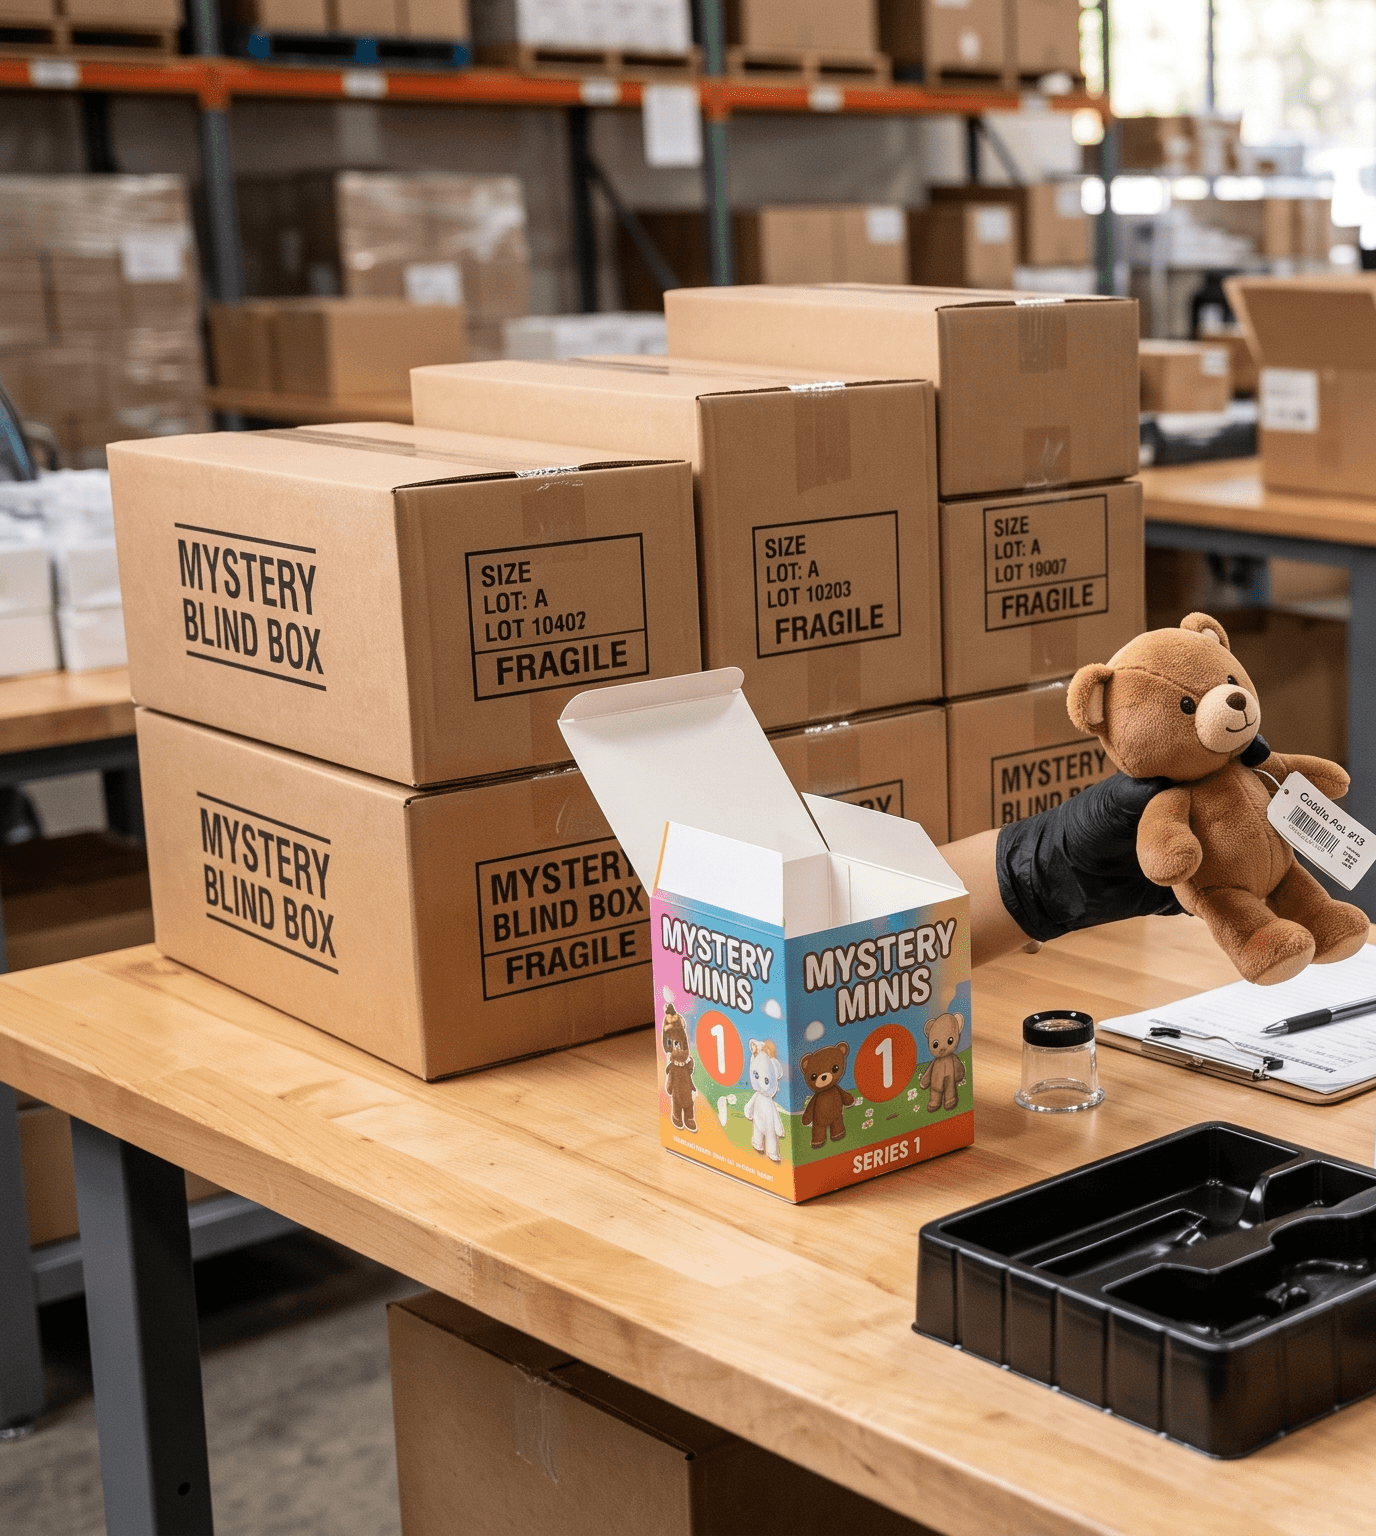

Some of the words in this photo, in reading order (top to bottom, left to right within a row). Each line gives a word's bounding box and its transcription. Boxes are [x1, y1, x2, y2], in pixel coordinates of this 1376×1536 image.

[765, 535, 806, 559] SIZE
[994, 516, 1029, 537] SIZE
[995, 540, 1026, 560] LOT:
[1030, 538, 1041, 556] A
[178, 539, 316, 615] MYSTERY
[481, 561, 532, 587] SIZE
[766, 562, 802, 583] LOT:
[808, 560, 819, 578] A
[767, 587, 800, 608] LOT
[806, 580, 851, 602] 10203
[995, 563, 1024, 583] LOT
[484, 591, 527, 614] LOT:
[534, 588, 548, 608] A
[775, 604, 884, 644] FRAGILE
[1002, 583, 1093, 620] FRAGILE
[183, 598, 258, 656] BLIND
[267, 618, 324, 674] BOX
[485, 618, 524, 642] LOT
[497, 640, 627, 685] FRAGILE
[1002, 748, 1106, 795] MYSTERY
[200, 807, 330, 900] MYSTERY
[204, 863, 275, 930] BLIND
[283, 895, 337, 958] BOX
[493, 899, 578, 943] BLIND
[589, 885, 643, 922] BOX
[506, 930, 636, 984] FRAGILE
[661, 914, 773, 982] MYSTERY
[804, 918, 957, 992] MYSTERY
[683, 957, 753, 1013] MINIS
[837, 966, 931, 1025] MINIS
[710, 1024, 726, 1074] 1
[875, 1037, 893, 1088] 1
[853, 1140, 909, 1174] SERIES
[913, 1136, 921, 1153] 1
